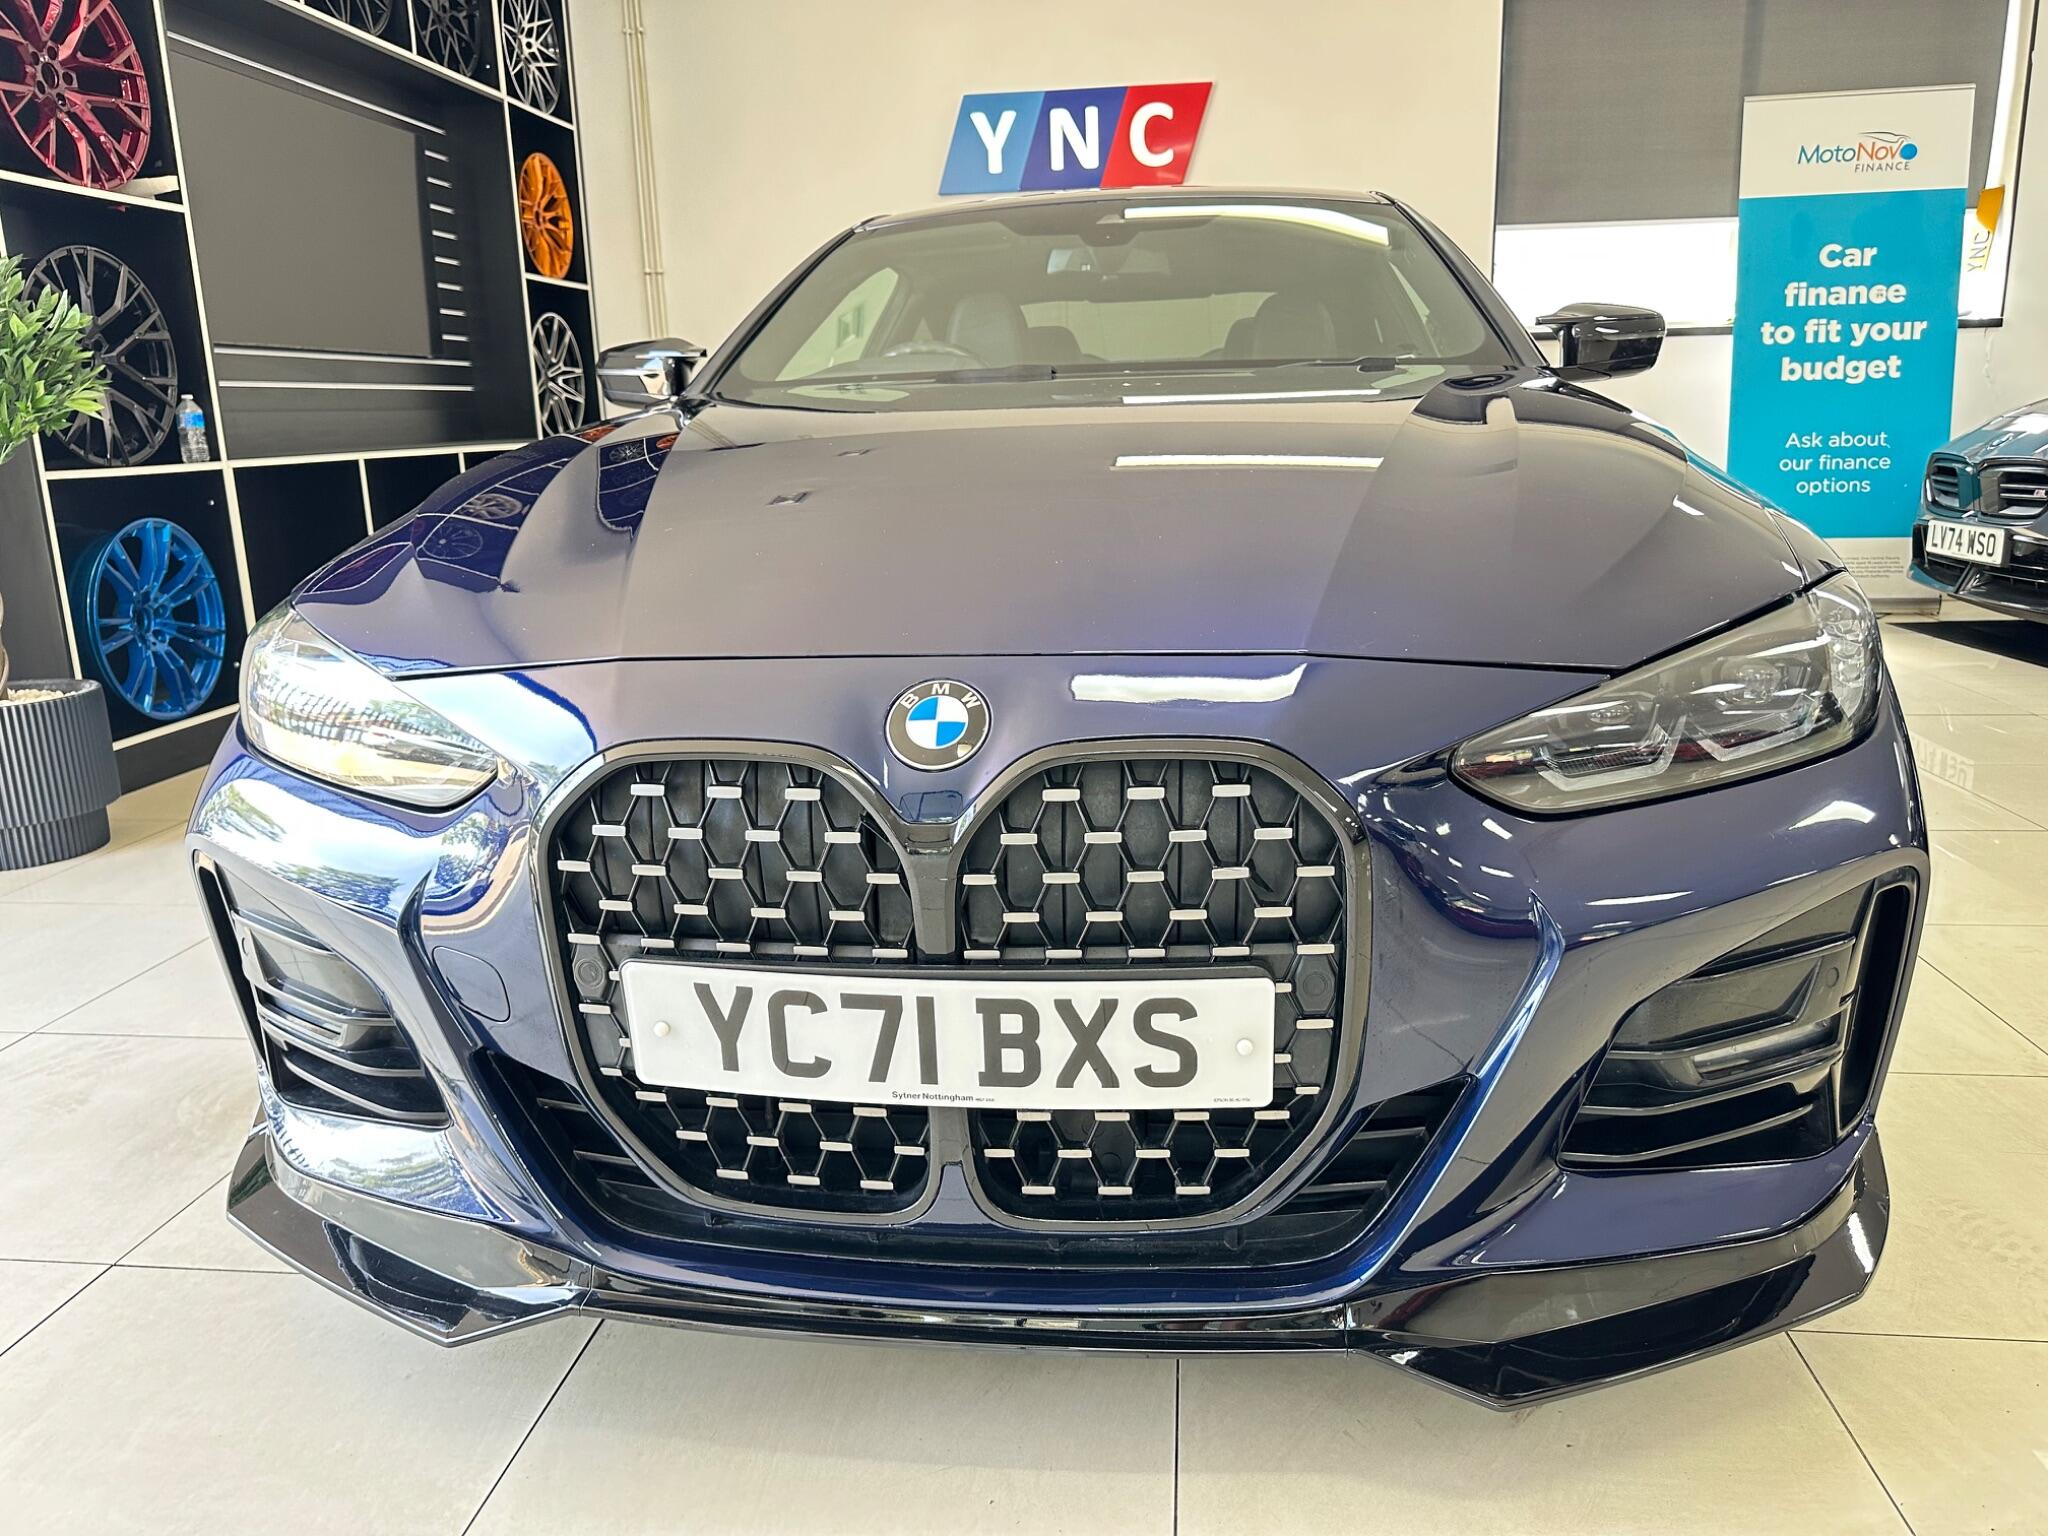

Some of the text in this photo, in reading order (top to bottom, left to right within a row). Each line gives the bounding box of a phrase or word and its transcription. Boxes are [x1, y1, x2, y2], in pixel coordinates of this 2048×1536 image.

[969, 101, 1174, 175] YNC
[1854, 161, 1911, 173] FINANCE
[1819, 243, 1878, 268] Car
[1784, 282, 1907, 307] finance
[1760, 318, 1928, 347] to fit your
[1780, 355, 1902, 384] budget
[1785, 431, 1888, 449] Ask about
[1779, 454, 1892, 472] our finance
[1795, 477, 1872, 497] options
[1930, 523, 1998, 558] LV74 WSO
[900, 683, 981, 710] BMW
[693, 982, 1199, 1089] YC71 BXS
[891, 1090, 921, 1100] Sytner
[922, 1092, 974, 1103] Nottingham
